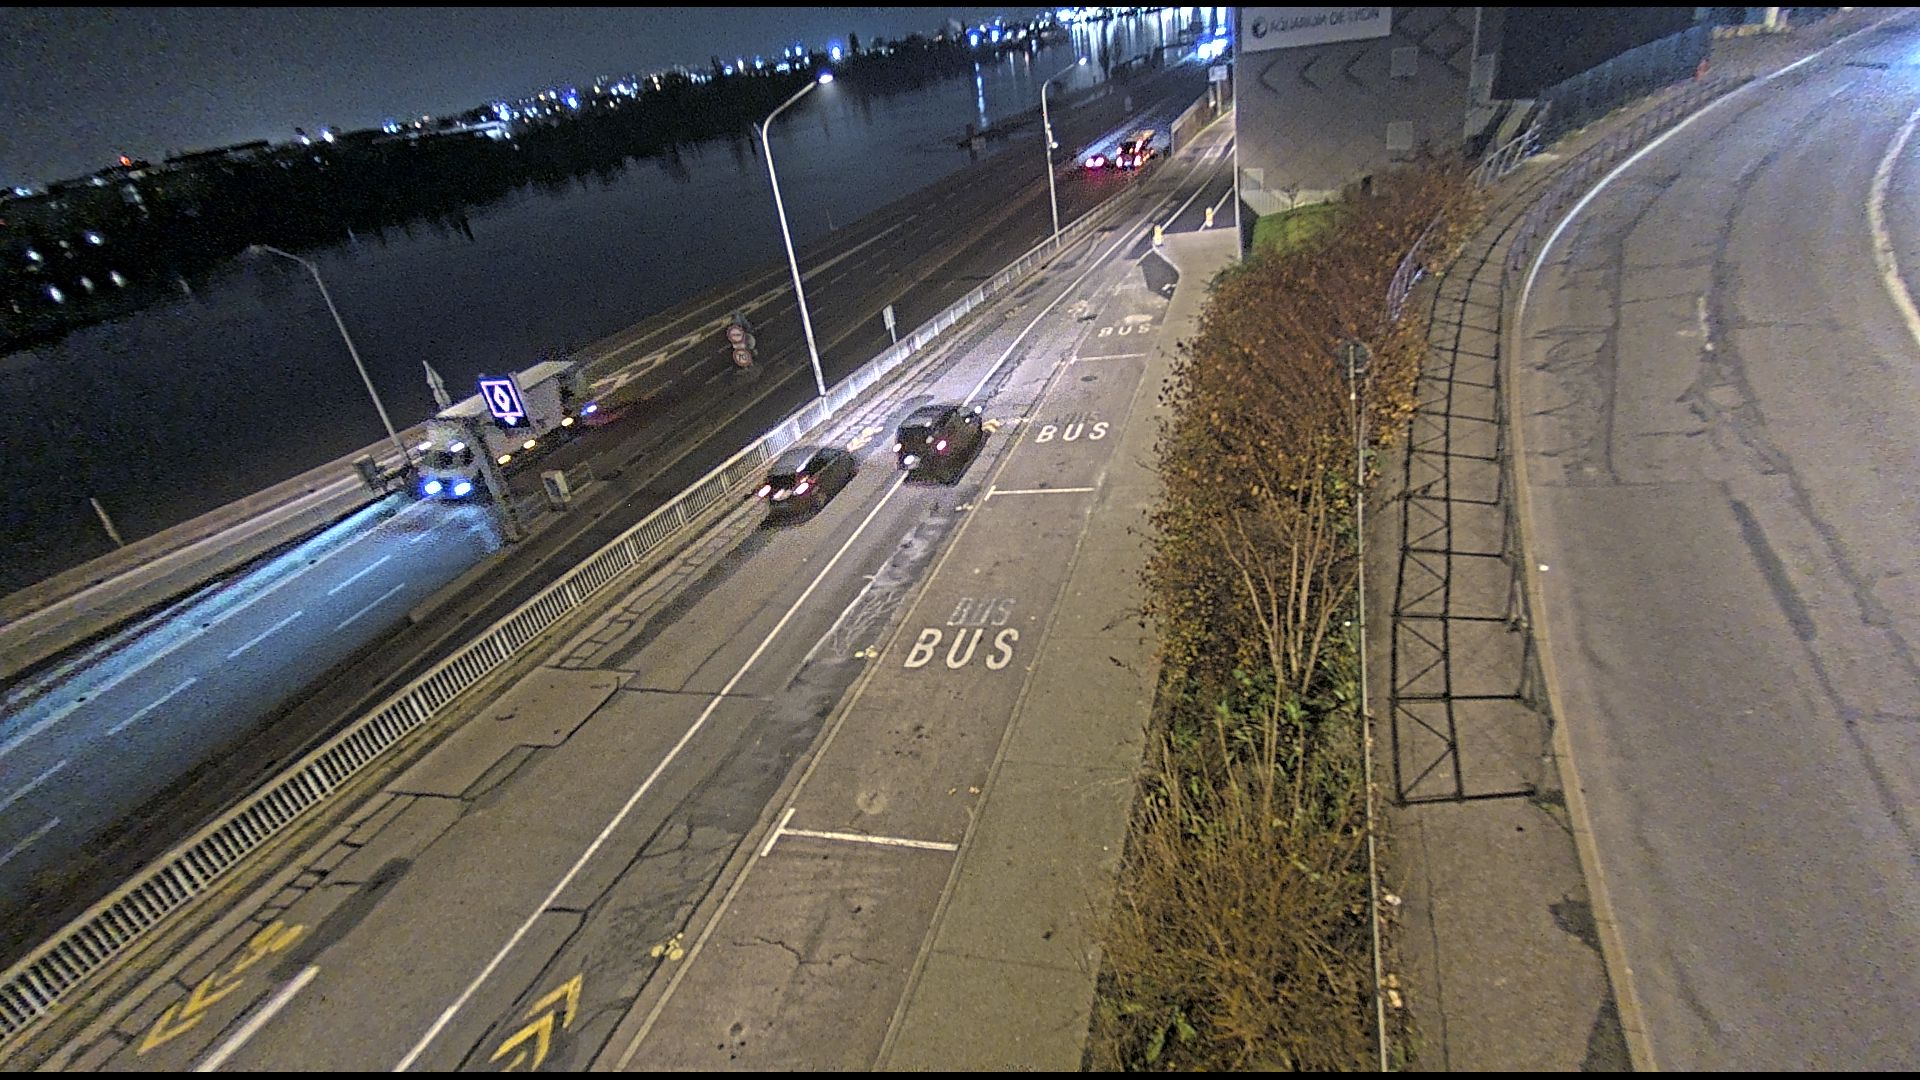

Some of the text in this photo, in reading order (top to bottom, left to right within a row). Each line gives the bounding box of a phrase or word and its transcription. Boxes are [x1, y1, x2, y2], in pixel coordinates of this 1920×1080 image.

[1098, 323, 1150, 337] BUS
[1035, 421, 1109, 443] BUS
[904, 628, 1019, 670] BUS
